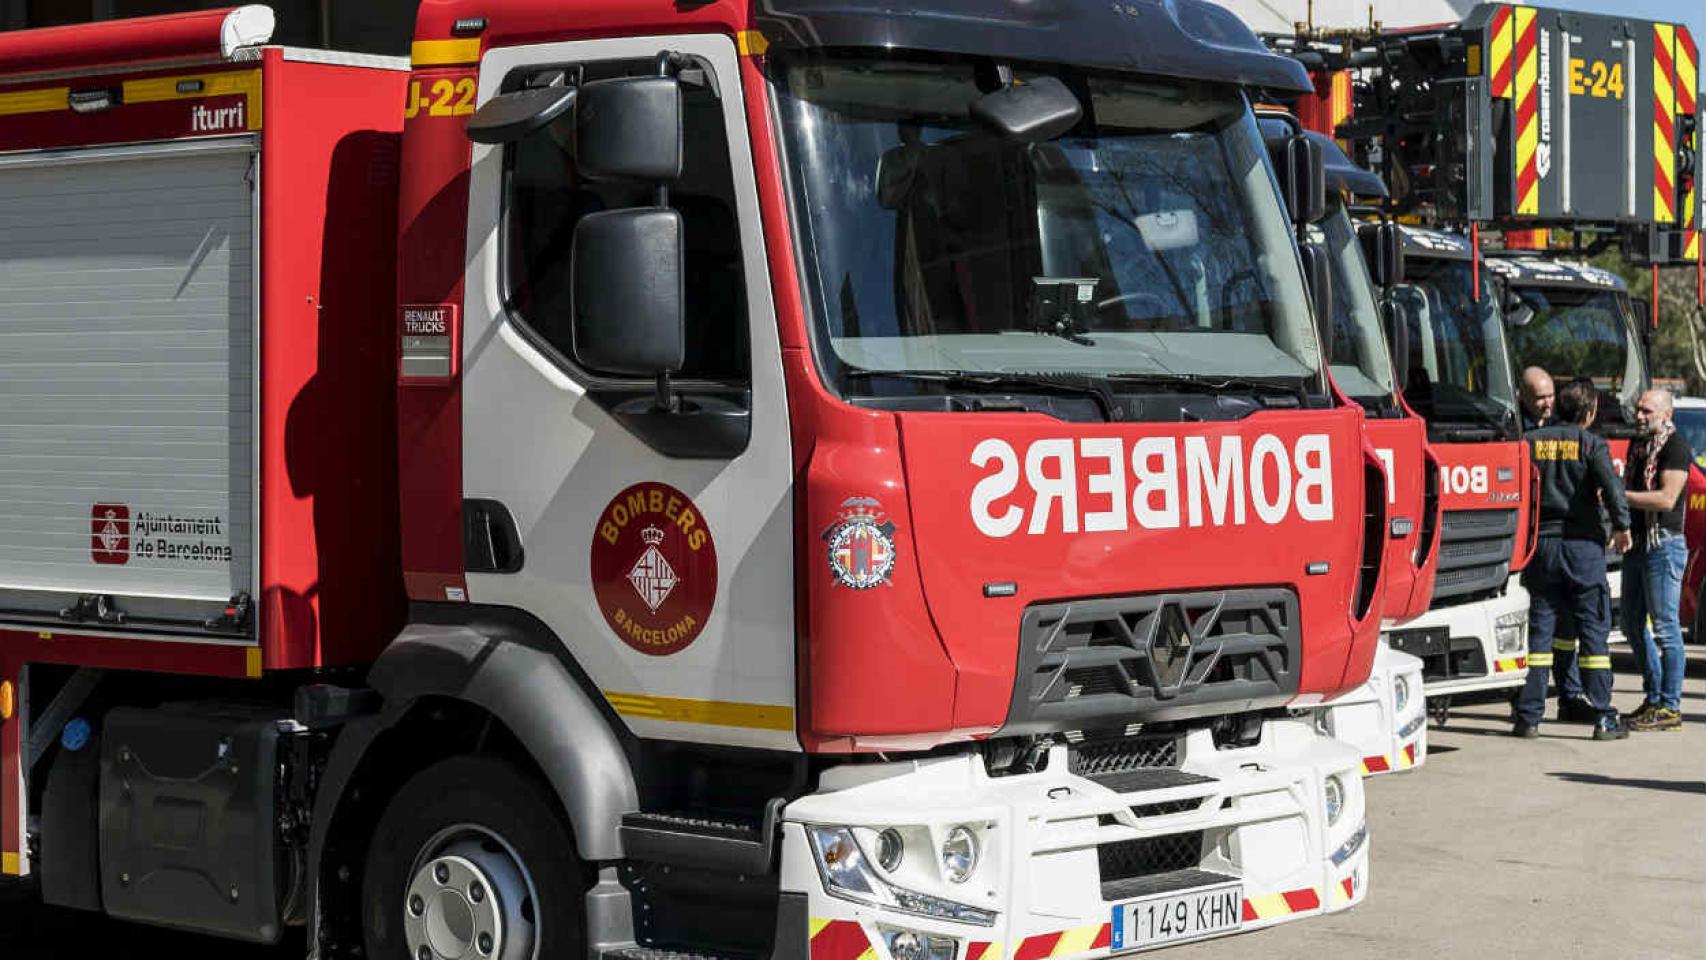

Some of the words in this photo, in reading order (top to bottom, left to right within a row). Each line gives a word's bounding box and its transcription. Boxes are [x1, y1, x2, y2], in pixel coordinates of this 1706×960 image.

[1569, 58, 1625, 100] E-24
[192, 101, 243, 131] iturri
[404, 310, 446, 321] RENAULT
[405, 321, 446, 333] TRUCKS
[135, 512, 222, 537] Ajuntament
[601, 489, 707, 550] BOMBERS
[136, 539, 154, 558] de
[157, 539, 232, 562] Barcelona
[613, 608, 697, 646] BARCELONA
[1132, 901, 1188, 942] 1149
[1196, 891, 1238, 931] KHN
